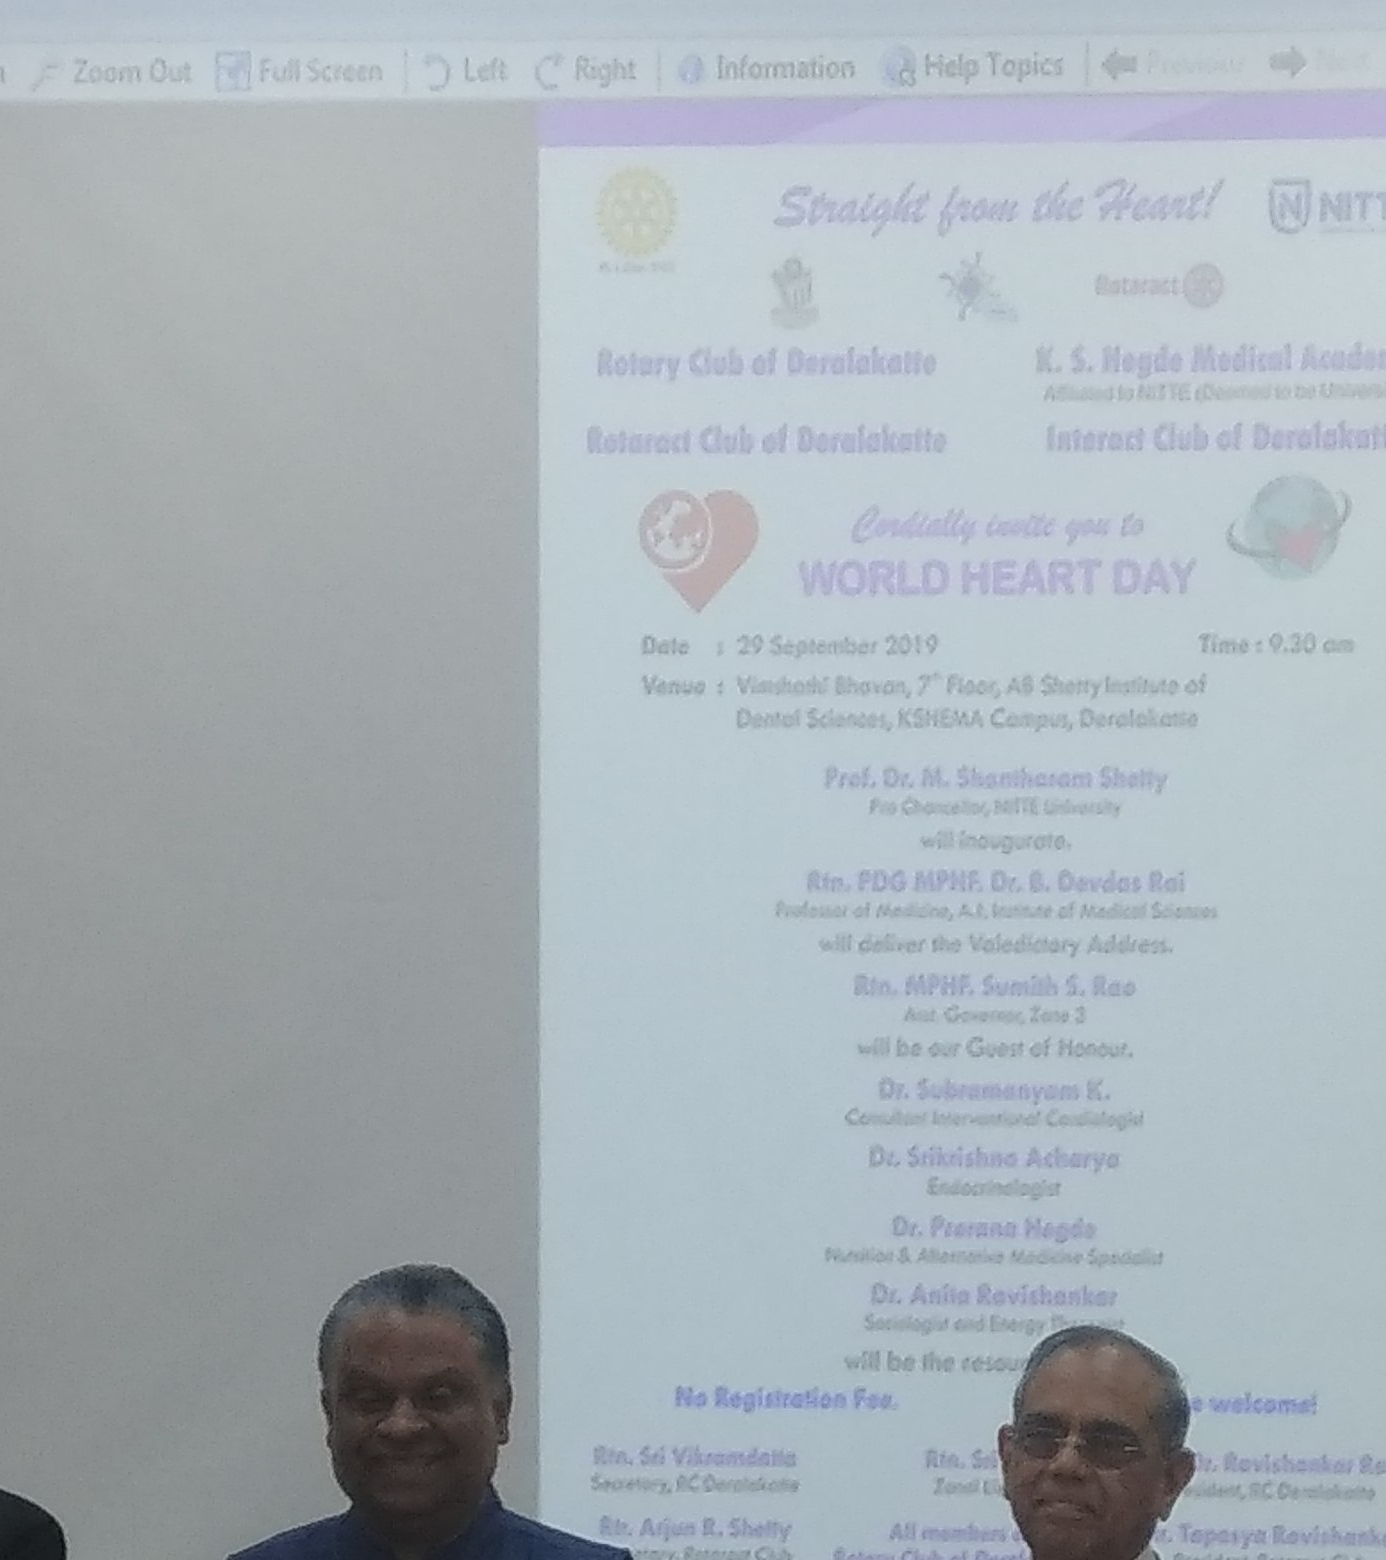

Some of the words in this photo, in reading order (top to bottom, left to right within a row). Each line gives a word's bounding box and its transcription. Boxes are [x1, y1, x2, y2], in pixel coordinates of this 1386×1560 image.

[73, 59, 137, 84] Zoom
[149, 58, 193, 84] Out
[259, 59, 301, 84] Full
[305, 58, 384, 83] Screen
[463, 56, 509, 83] Left
[574, 54, 637, 86] Right
[716, 54, 857, 81] Information
[924, 52, 981, 82] Help
[988, 52, 1065, 82] Topics
[773, 180, 930, 237] Straight
[937, 184, 1019, 236] from
[1031, 183, 1084, 224] the
[1093, 179, 1225, 224] Heart!
[1094, 272, 1180, 297] Rotaract
[597, 347, 680, 382] Rotary
[688, 347, 744, 377] Club
[751, 347, 778, 377] of
[787, 348, 937, 377] Deralakatte
[1035, 344, 1063, 373] K.
[1070, 344, 1094, 373] S.
[1102, 343, 1184, 378] Hegde
[1191, 343, 1293, 373] Medical
[586, 424, 692, 455] Rotaract
[699, 424, 754, 455] Club
[761, 424, 788, 454] of
[797, 424, 947, 454] Deralakatte
[1045, 421, 1145, 452] Interact
[1153, 420, 1210, 452] Club
[1216, 420, 1244, 452] of
[851, 504, 978, 547] Cordially
[984, 508, 1057, 540] invite
[1063, 517, 1113, 548] you
[1119, 510, 1145, 540] to
[798, 560, 951, 597] WORLD
[960, 559, 1103, 596] HEART
[1112, 559, 1198, 596] DAY
[641, 633, 690, 656] Date
[737, 633, 764, 656] 29
[769, 633, 878, 660] September
[884, 632, 940, 656] 2019
[1197, 631, 1250, 655] Time
[1268, 631, 1318, 655] 9.30
[1322, 636, 1357, 655] am
[823, 765, 878, 790] Prof.
[883, 765, 915, 790] Dr.
[921, 765, 949, 790] M.
[956, 764, 1093, 790] Shantharam
[1099, 764, 1169, 796] Shetty
[806, 868, 852, 893] Rtn.
[857, 868, 908, 893] PDG
[989, 868, 1024, 893] Dr.
[1057, 867, 1142, 893] Devdas
[1148, 867, 1187, 893] Rai
[877, 1076, 909, 1100] Dr.
[916, 1076, 1080, 1105] Subramanyam
[1085, 1076, 1111, 1101] K.
[867, 1143, 902, 1169] Dr.
[907, 1144, 1018, 1168] Srikrishna
[1025, 1144, 1121, 1175] Acharya
[674, 1384, 708, 1408] No
[714, 1385, 847, 1414] Registration
[853, 1384, 900, 1411] Fee.
[1208, 1390, 1319, 1416] welcome!
